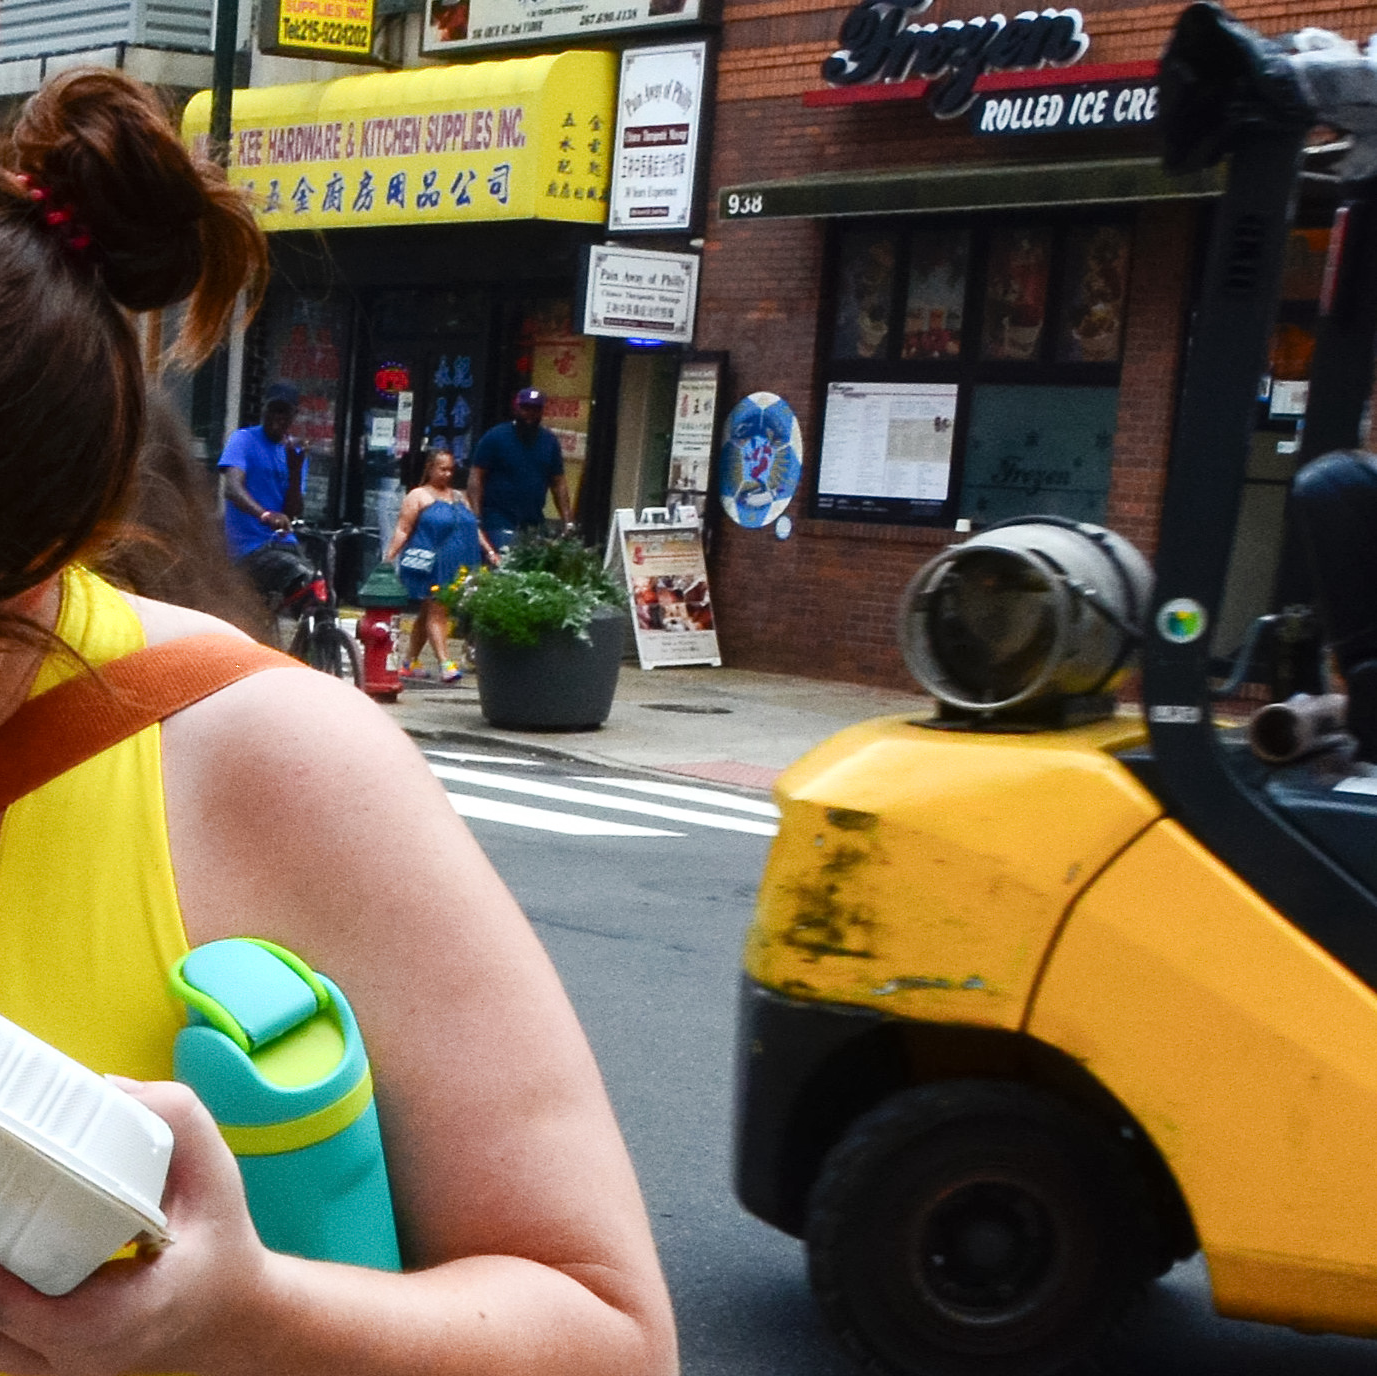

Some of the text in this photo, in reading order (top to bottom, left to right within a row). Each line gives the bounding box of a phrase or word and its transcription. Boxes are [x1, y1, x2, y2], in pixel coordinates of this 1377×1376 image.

[981, 94, 1063, 131] ROLLED
[1068, 90, 1108, 125] ICE
[268, 122, 343, 164] HARDWARE
[346, 121, 355, 159] &
[361, 116, 422, 158] KITCHEN
[425, 110, 493, 153] SUPPLIES
[497, 107, 525, 149] INC.
[727, 193, 763, 214] 938
